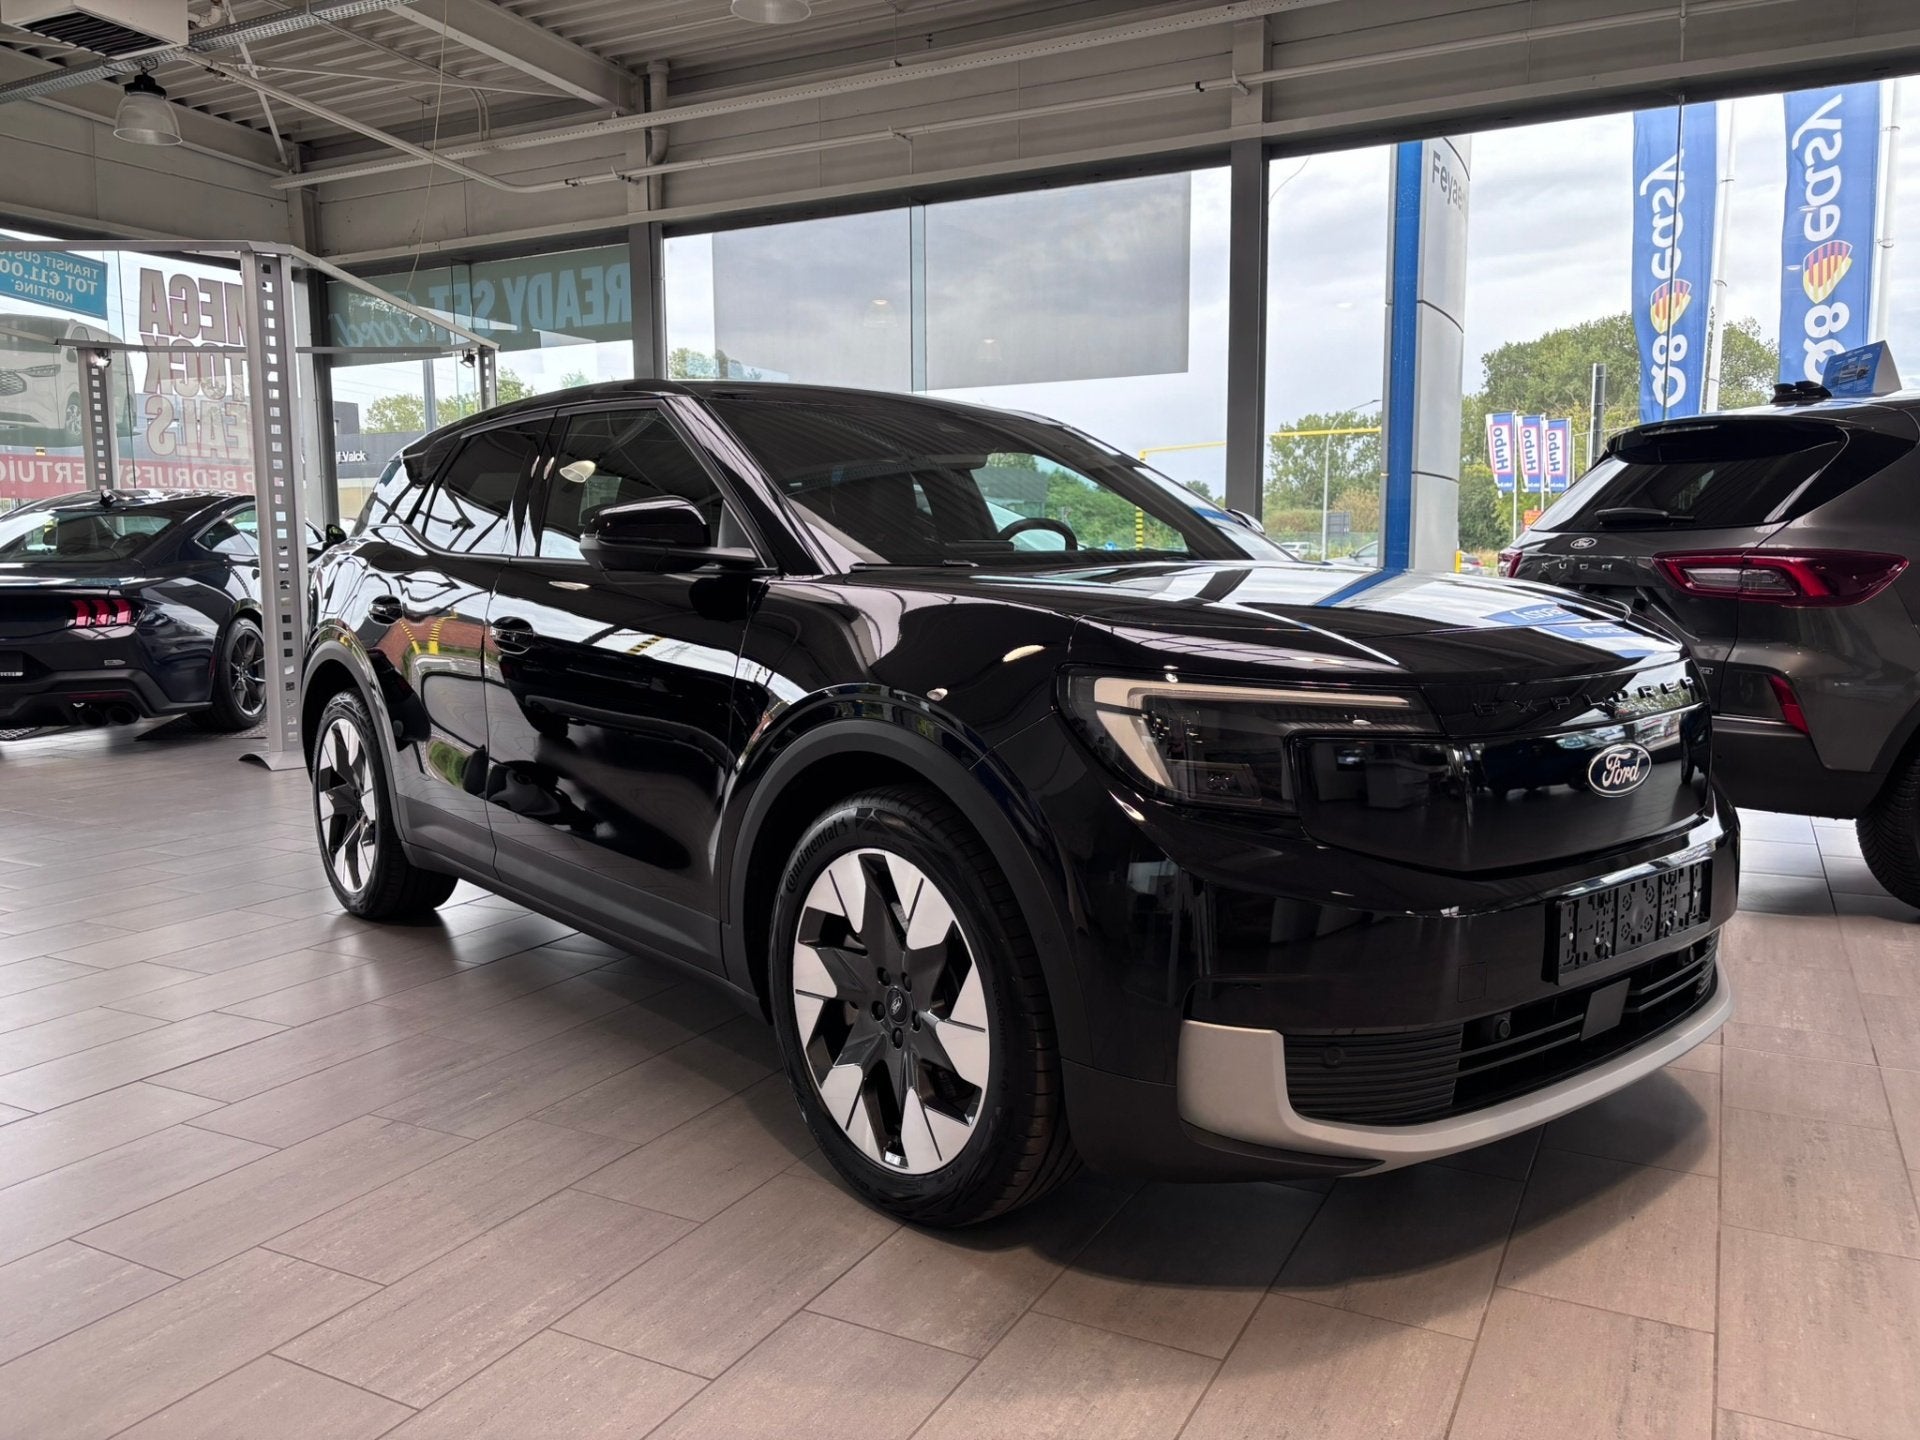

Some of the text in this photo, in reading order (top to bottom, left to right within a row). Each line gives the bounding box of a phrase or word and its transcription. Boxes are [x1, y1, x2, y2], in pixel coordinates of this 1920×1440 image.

[1432, 150, 1464, 211] Feyae
[1473, 676, 1694, 717] EXPLORER
[1601, 752, 1641, 788] Ford
[785, 819, 839, 894] Continental
